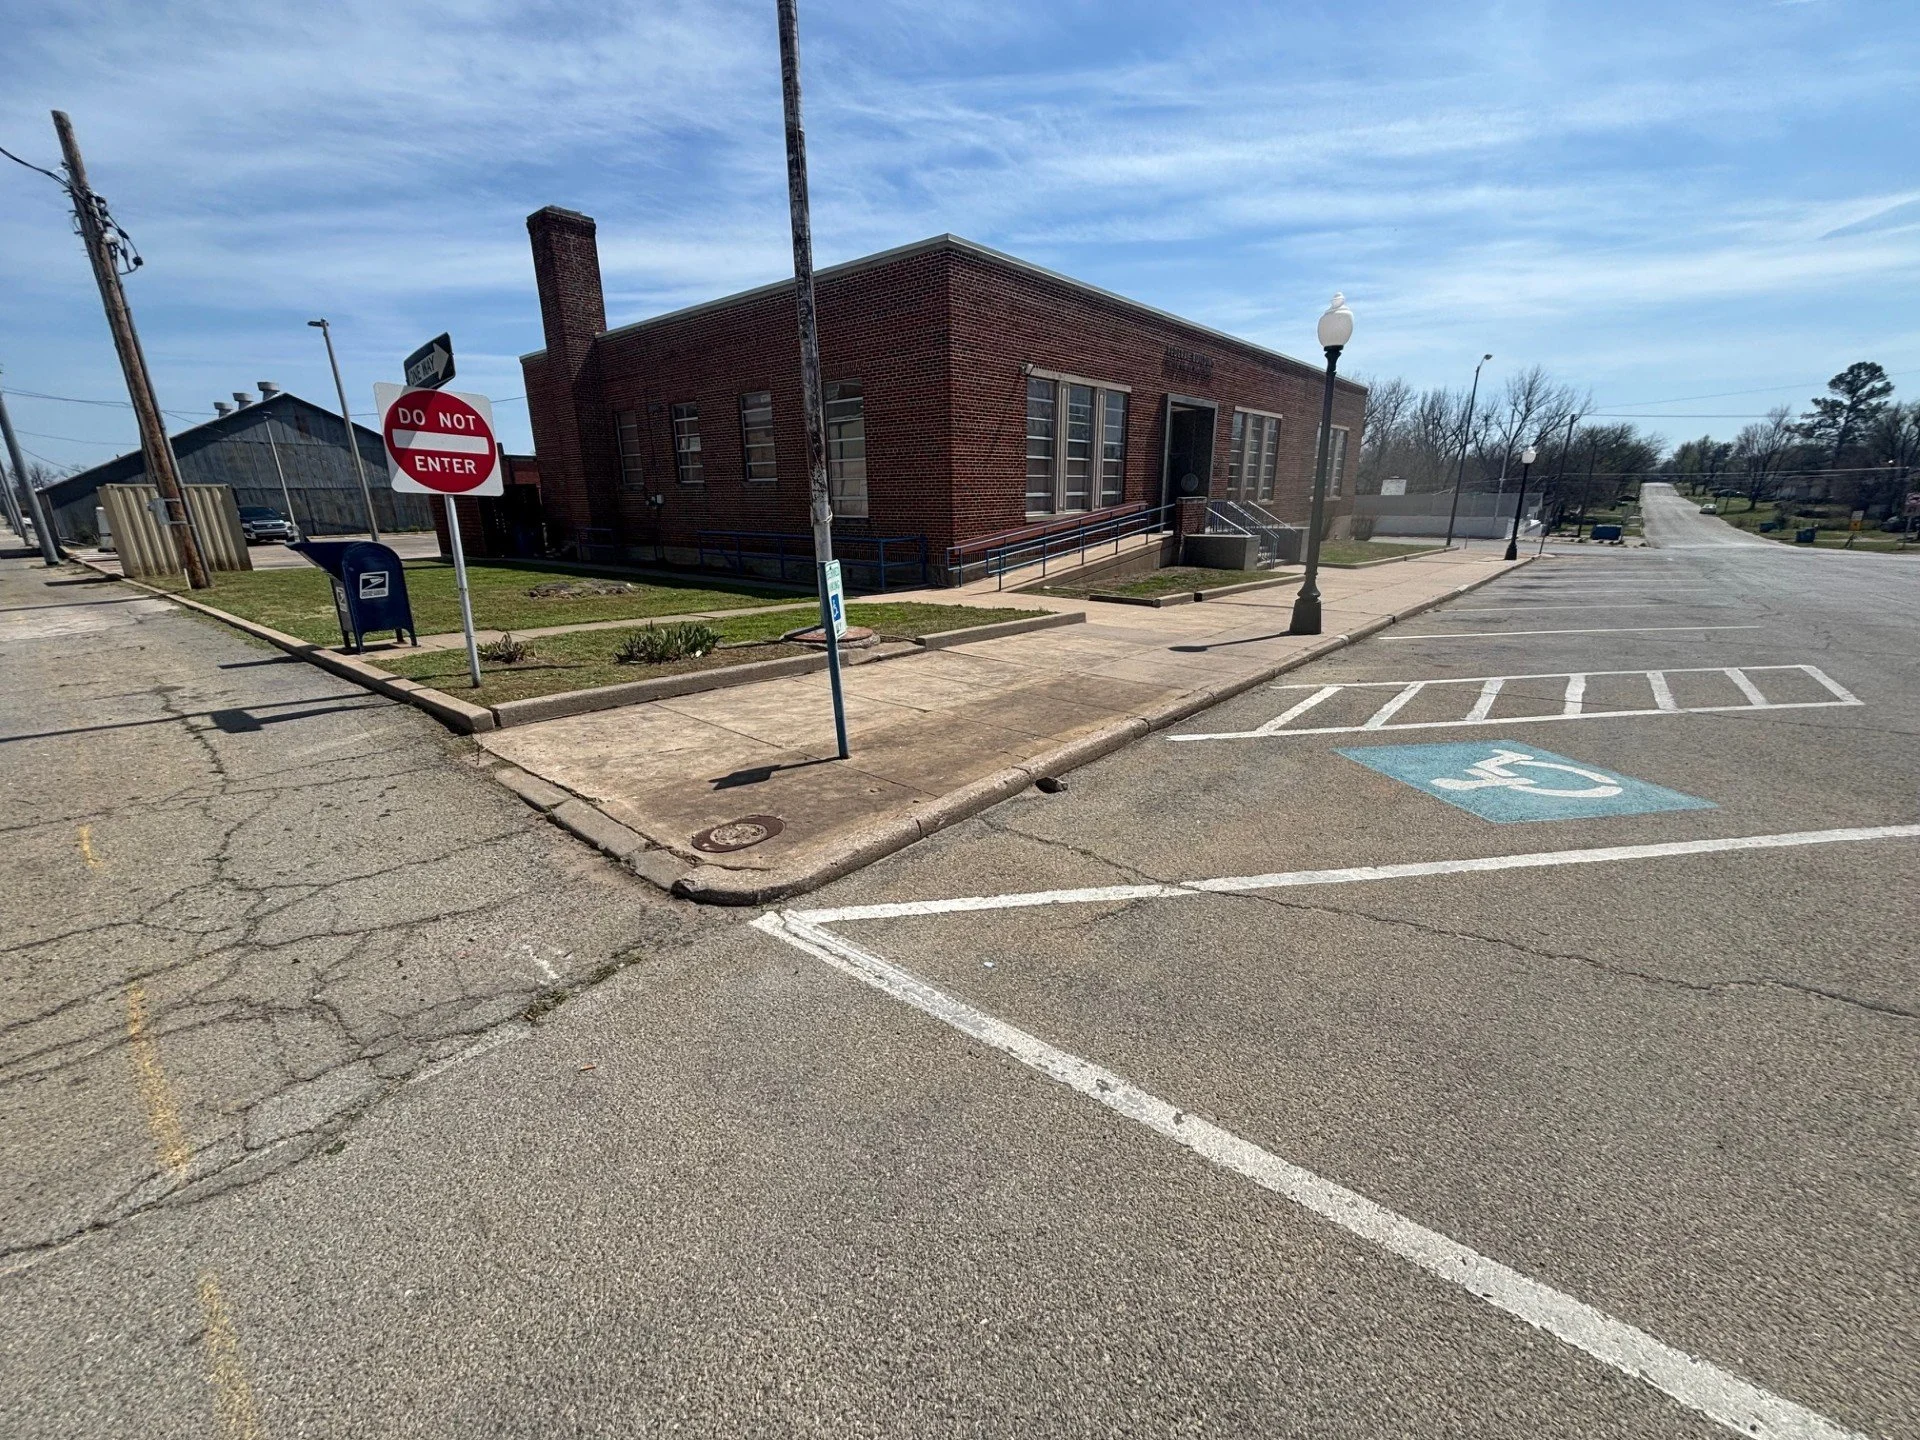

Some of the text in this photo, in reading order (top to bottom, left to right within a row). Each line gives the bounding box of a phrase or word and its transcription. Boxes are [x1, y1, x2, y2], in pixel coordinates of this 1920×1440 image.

[409, 355, 435, 385] ONE WAY
[398, 407, 476, 431] DO NOT
[414, 455, 477, 475] ENTER
